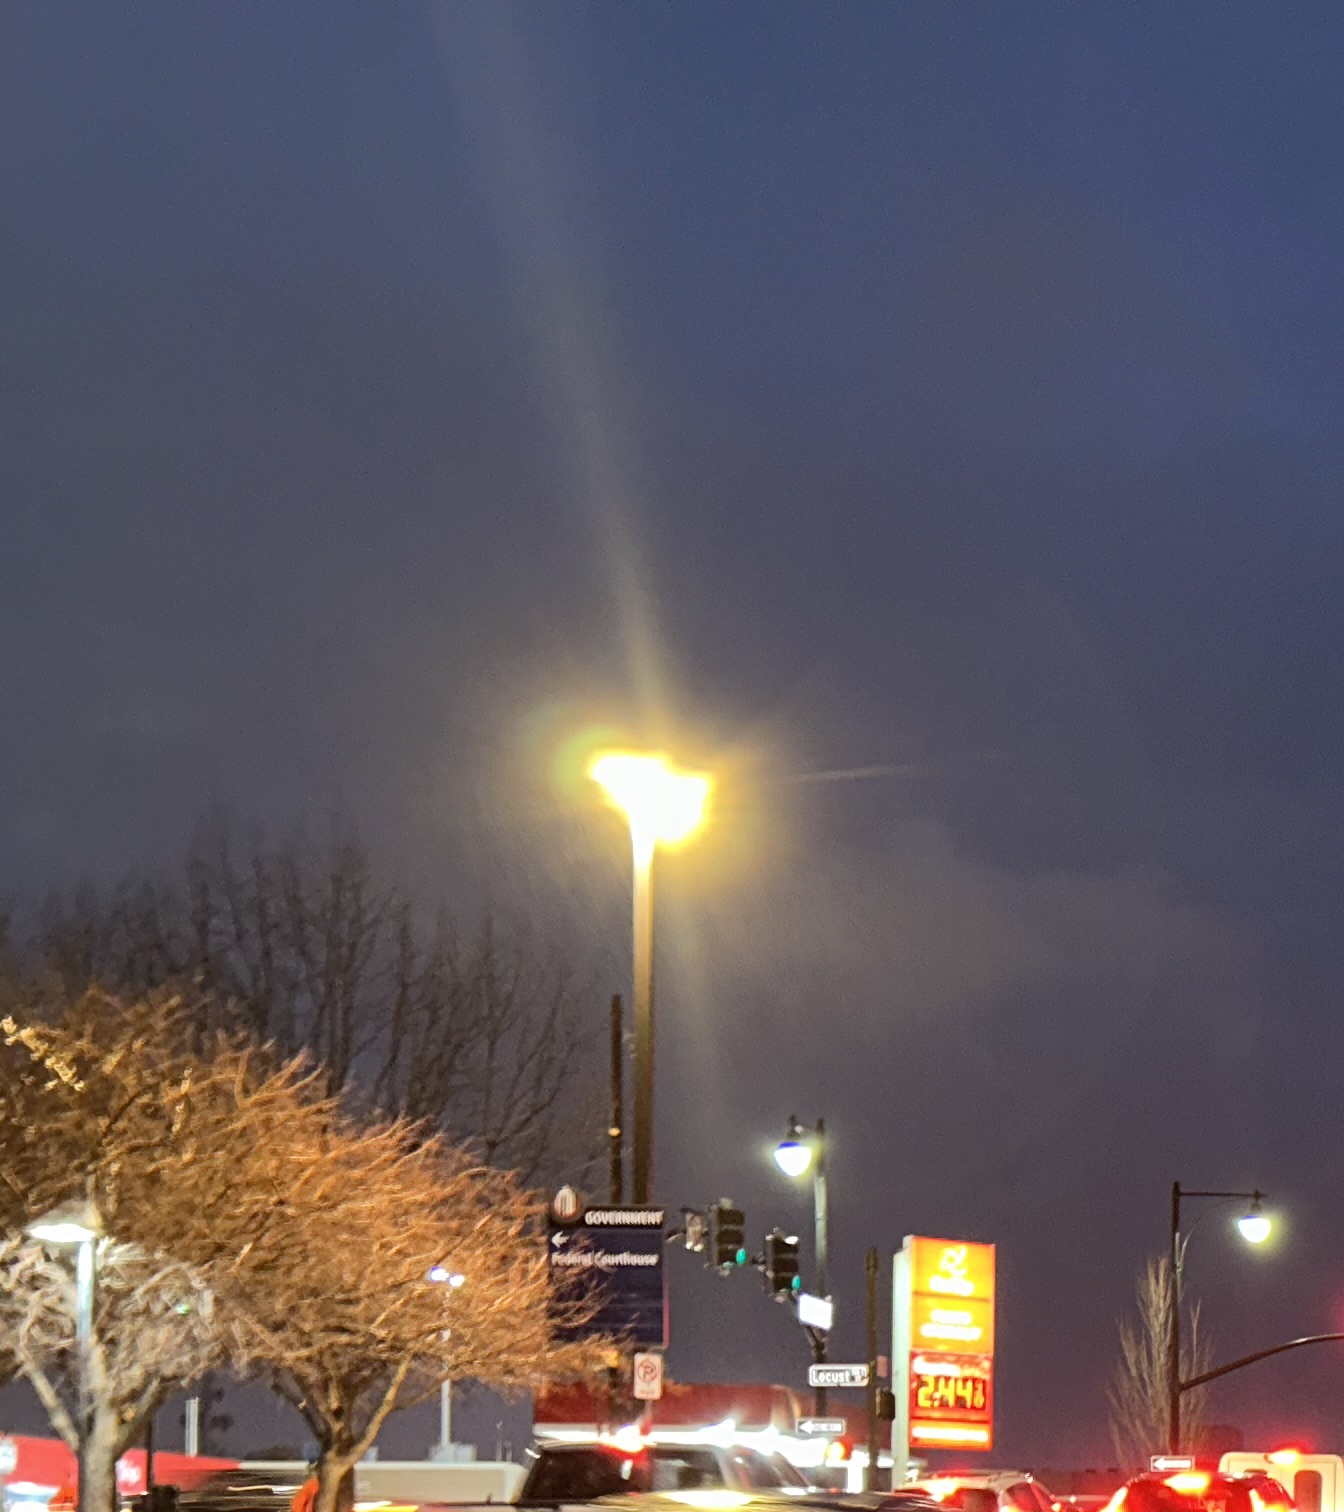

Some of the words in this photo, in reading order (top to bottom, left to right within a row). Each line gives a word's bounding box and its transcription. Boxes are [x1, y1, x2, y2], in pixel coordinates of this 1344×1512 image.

[584, 1209, 664, 1226] GOVERNMENT
[551, 1251, 595, 1267] Federal
[594, 1250, 659, 1267] Courthouse
[812, 1369, 850, 1383] Locust
